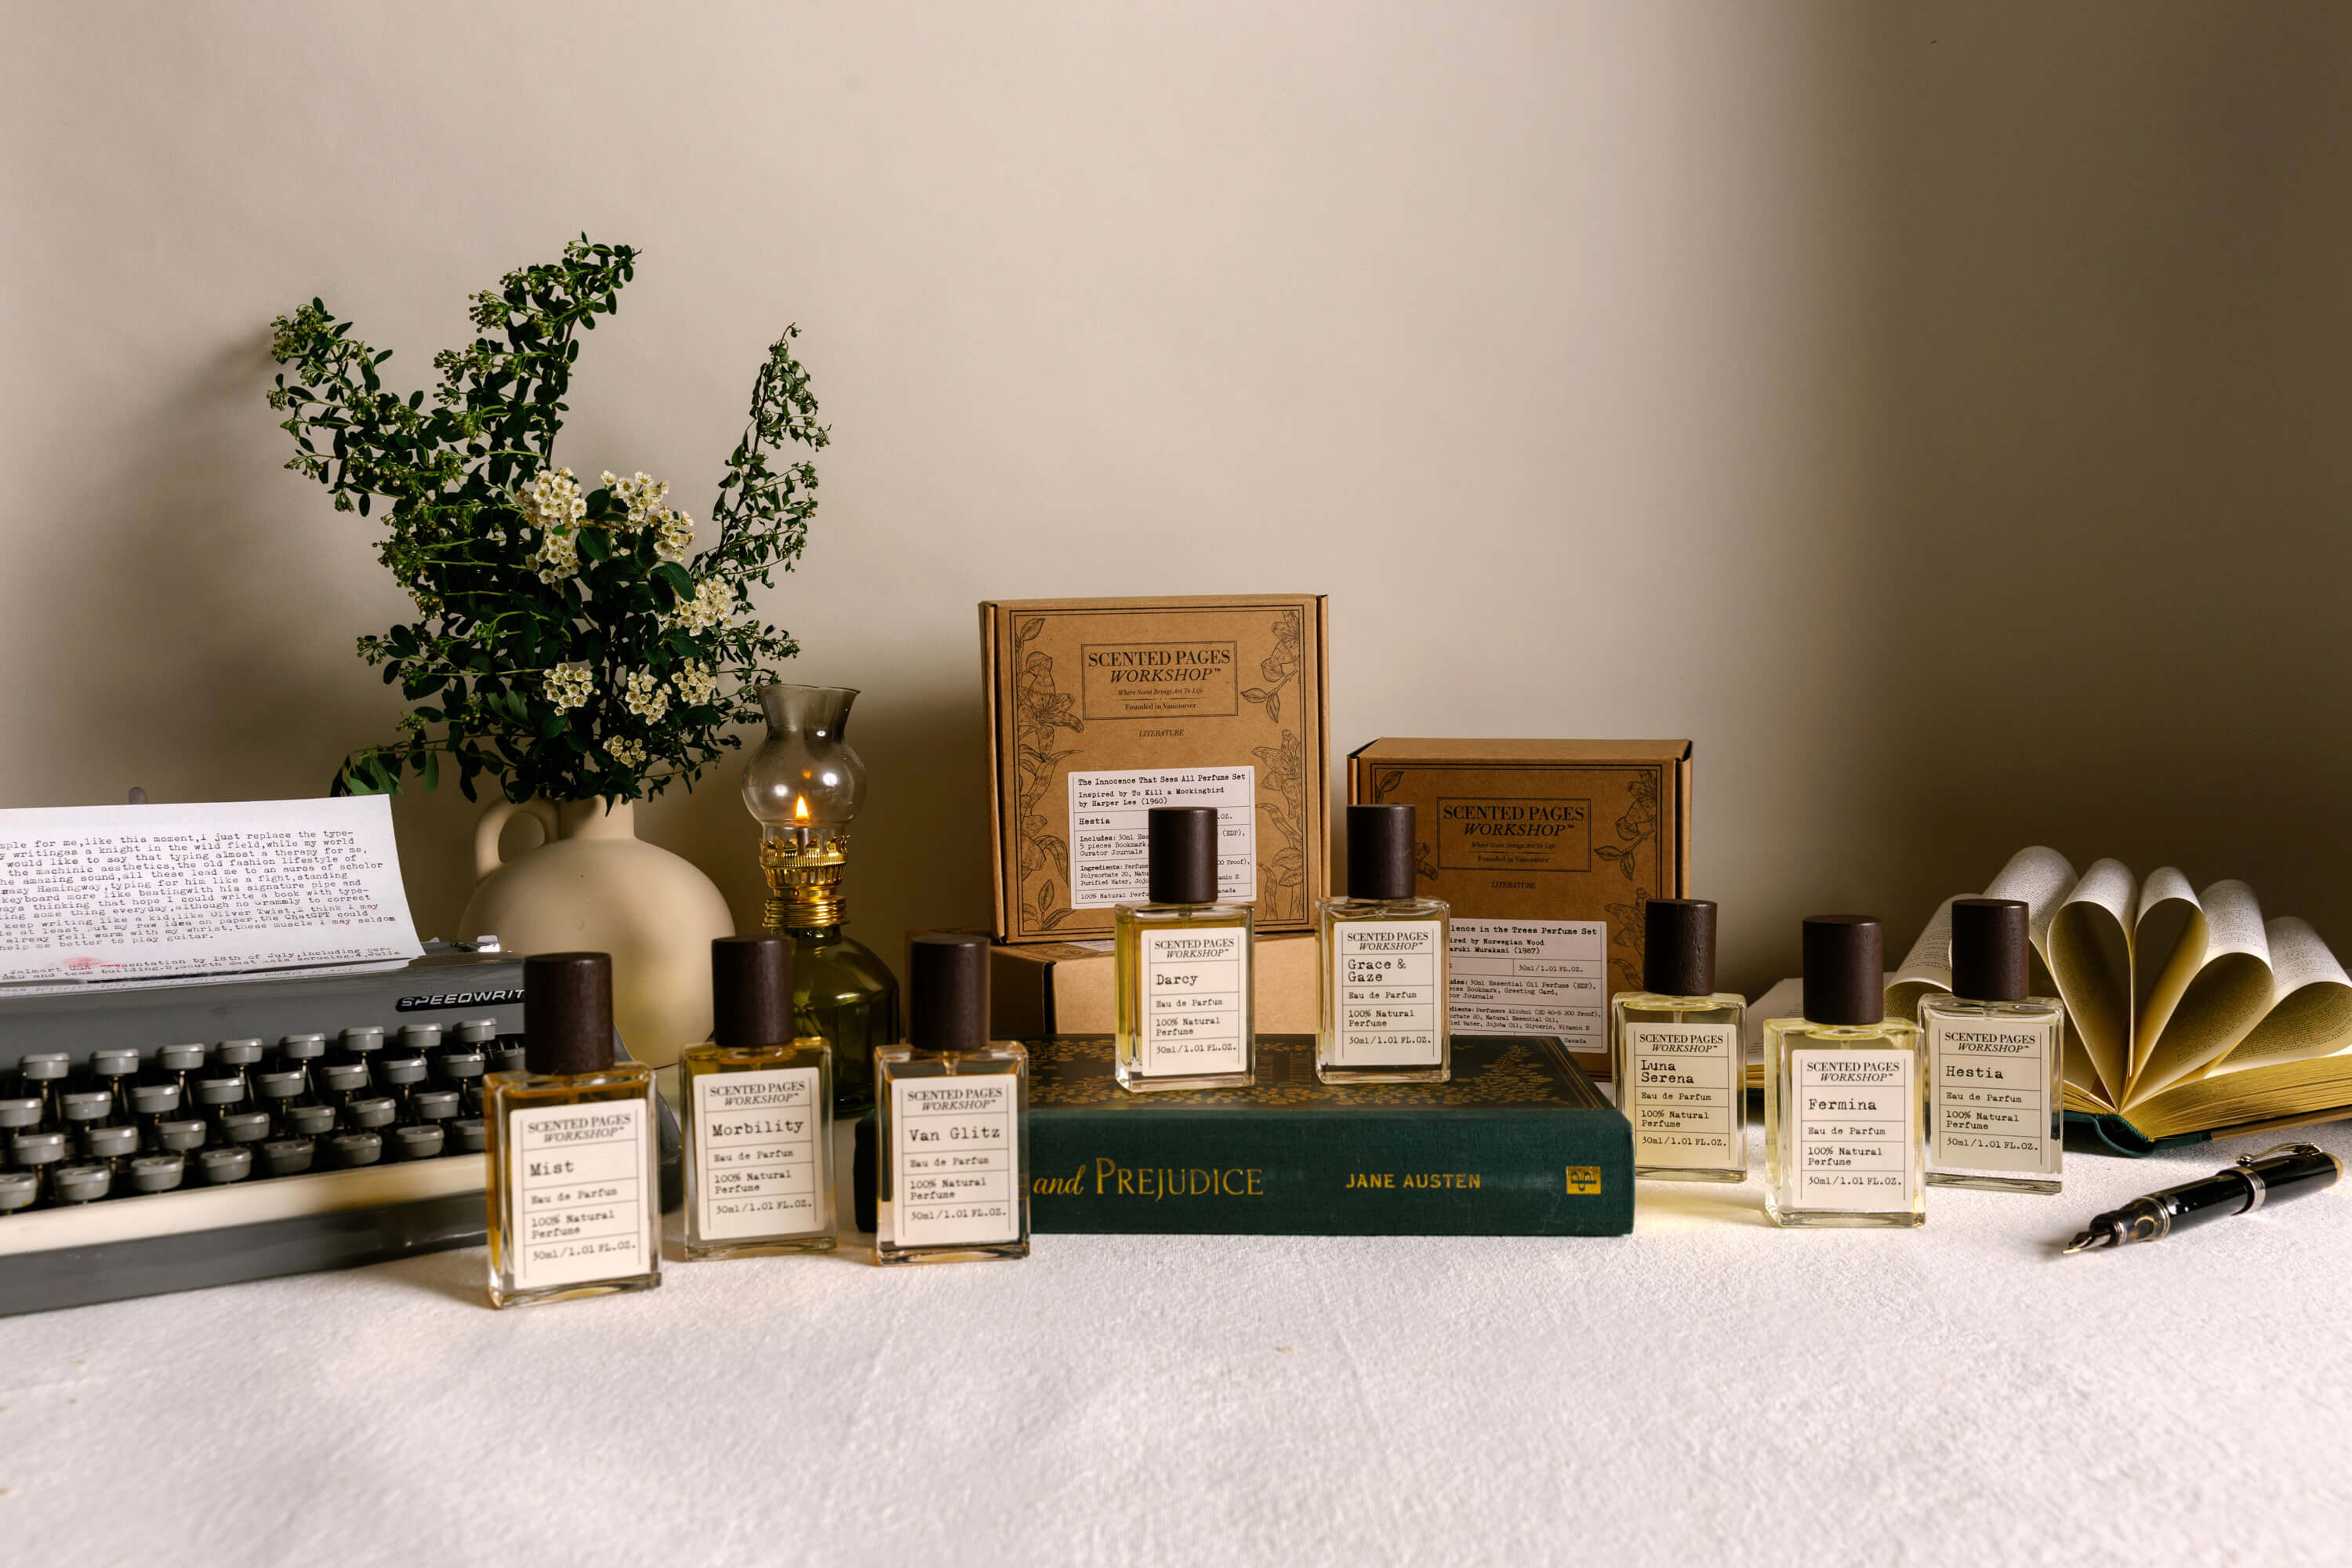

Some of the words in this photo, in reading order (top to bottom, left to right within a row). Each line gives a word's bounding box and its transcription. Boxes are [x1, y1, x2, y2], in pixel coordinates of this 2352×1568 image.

[1088, 652, 1171, 667] SCENTED
[1176, 650, 1230, 665] PAGES
[1139, 729, 1184, 738] LITERATURE
[1443, 805, 1524, 820] SCENTED
[1530, 807, 1584, 821] PAGES
[1155, 941, 1201, 949] SCENTED
[1203, 938, 1234, 948] PAGES
[1348, 960, 1391, 970] Grace
[1398, 959, 1406, 969] &
[1156, 975, 1198, 986] Darcy
[1348, 972, 1382, 982] Gaze
[1639, 1034, 1687, 1043] SCENTED
[1691, 1035, 1723, 1044] PAGES
[1945, 1033, 1997, 1043] SCENTED
[2000, 1035, 2035, 1044] PAGES
[1641, 1060, 1675, 1071] Luna
[1807, 1062, 1860, 1071] SCENTED
[1864, 1062, 1900, 1071] PAGES
[1642, 1073, 1693, 1083] Serena
[1946, 1066, 2004, 1080] Hestia
[710, 1083, 765, 1097] SCENTED
[769, 1081, 805, 1092] PAGES
[908, 1090, 963, 1101] SCENTED
[966, 1088, 1002, 1098] PAGES
[1808, 1098, 1877, 1110] Fermina
[1987, 1094, 2022, 1103] Parfum
[1947, 1110, 1970, 1119] 100%
[1976, 1112, 2019, 1122] Natural
[528, 1118, 588, 1134] SCENTED
[592, 1114, 630, 1126] PAGES
[713, 1120, 804, 1137] Morbility
[1947, 1120, 1988, 1129] Perfume
[909, 1130, 939, 1142] Van
[950, 1126, 1000, 1140] Glitz
[739, 1152, 750, 1160] de
[757, 1149, 793, 1158] Parfum
[1808, 1145, 1833, 1156] 100%
[953, 1156, 989, 1166] Parfum
[530, 1161, 574, 1177] Mist
[715, 1174, 741, 1183] 100%
[747, 1171, 791, 1181] Natural
[942, 1178, 986, 1187] Natural
[1033, 1164, 1086, 1195] and
[1345, 1174, 1395, 1189] JANE
[1403, 1174, 1480, 1189] AUSTEN
[715, 1185, 760, 1194] Perfume
[532, 1196, 550, 1204] Eau
[557, 1192, 571, 1202] de
[579, 1188, 617, 1199] Parfum
[910, 1192, 954, 1200] Perfume
[532, 1217, 560, 1228] 100%
[567, 1210, 614, 1223] Natural
[532, 1227, 580, 1239] Perfume
